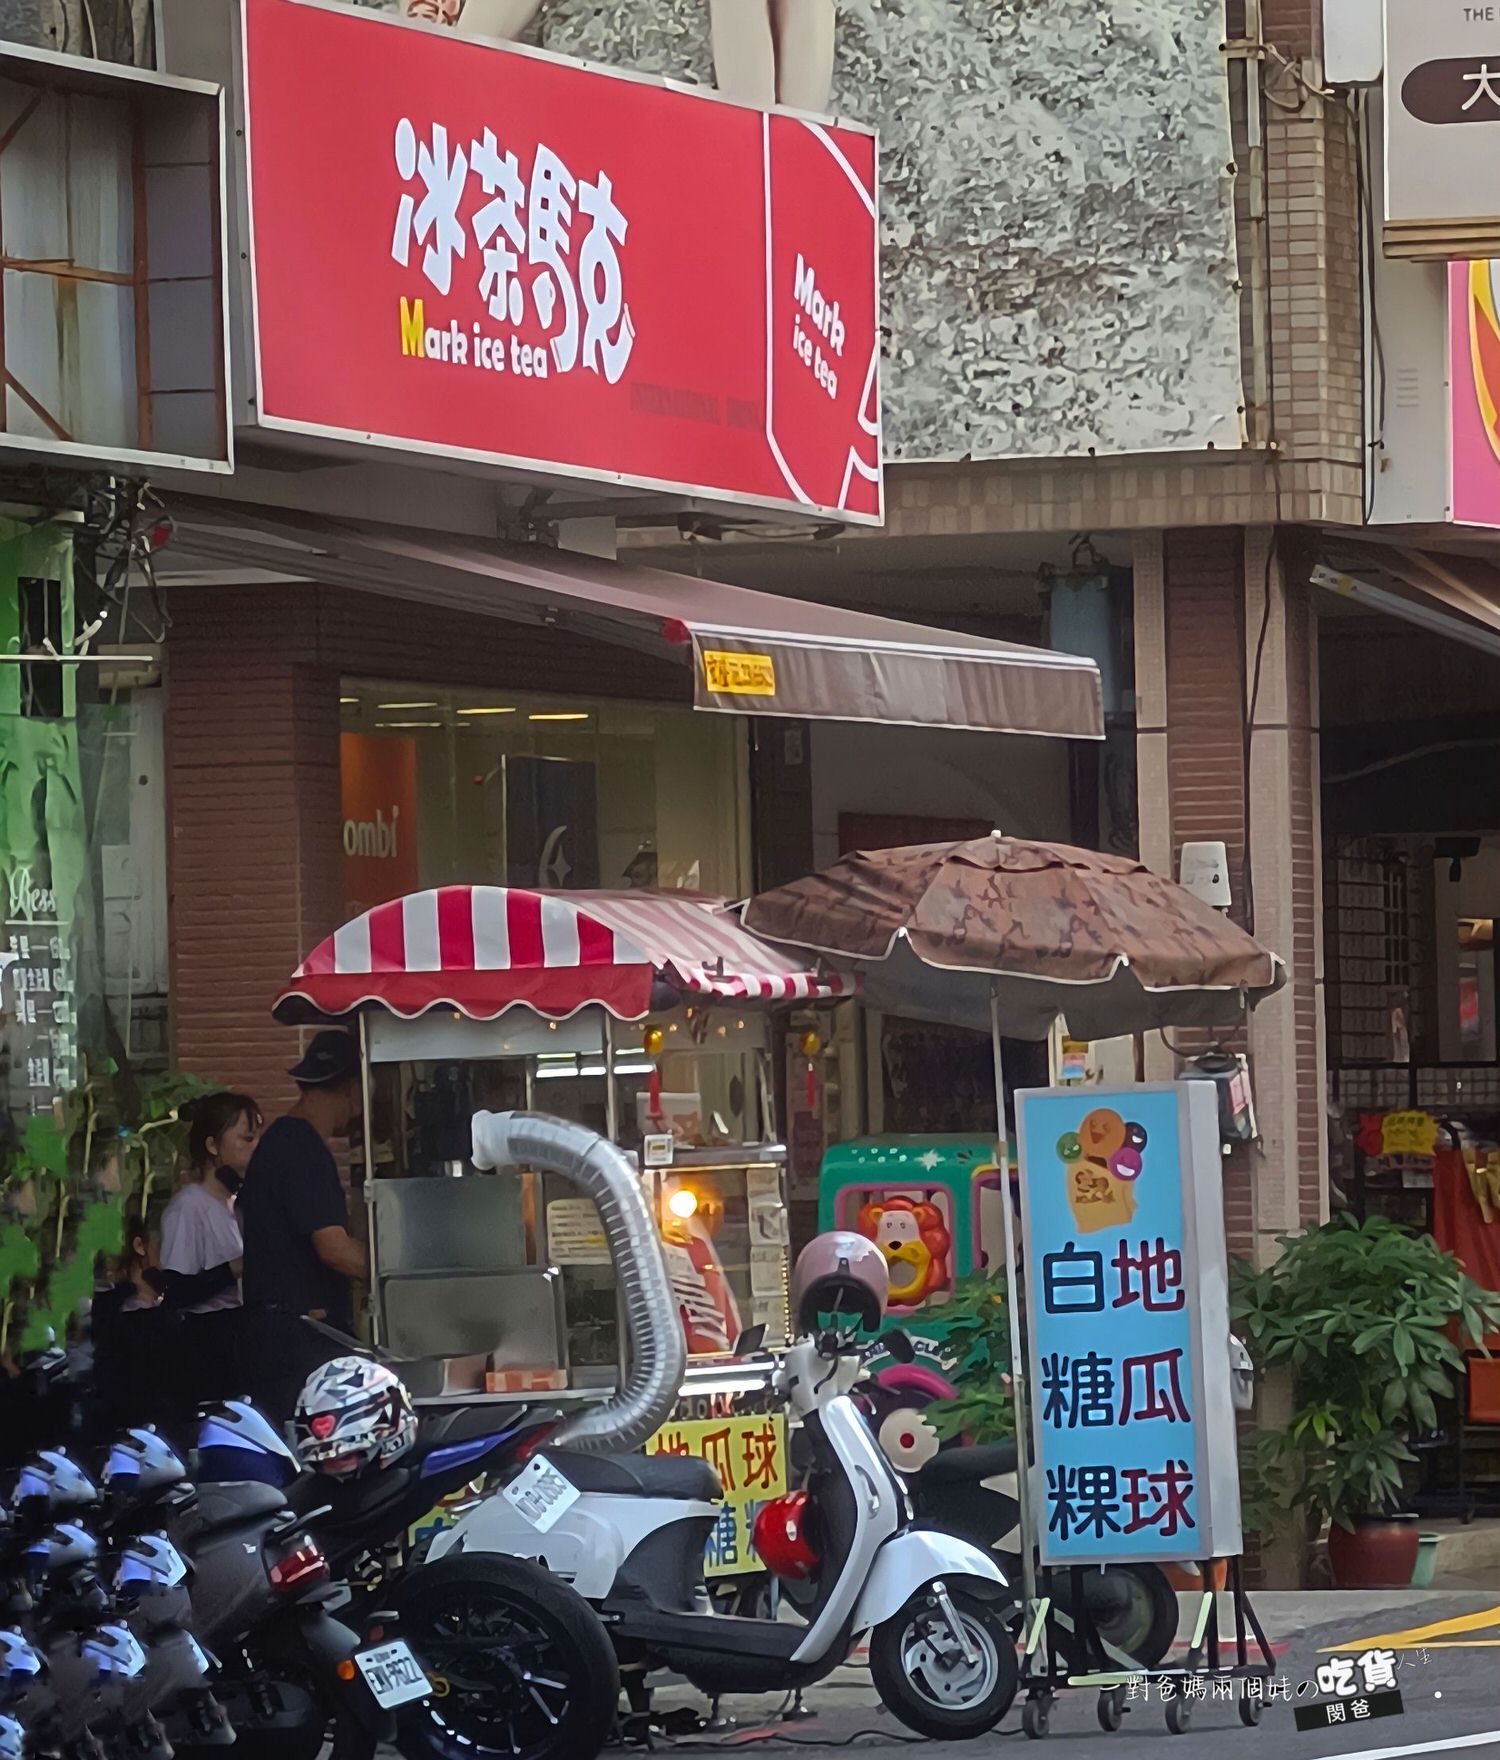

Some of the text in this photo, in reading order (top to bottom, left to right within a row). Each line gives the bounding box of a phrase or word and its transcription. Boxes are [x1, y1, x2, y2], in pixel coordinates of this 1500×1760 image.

[1462, 7, 1494, 21] THE
[1462, 64, 1500, 110] 大
[391, 117, 636, 385] 冰茶馬克
[400, 296, 548, 378] Mark ice tea
[793, 253, 845, 357] Mark
[793, 313, 838, 399] ice tea
[1041, 1241, 1122, 1541] 白糖粿
[1111, 1237, 1196, 1536] 地瓜球
